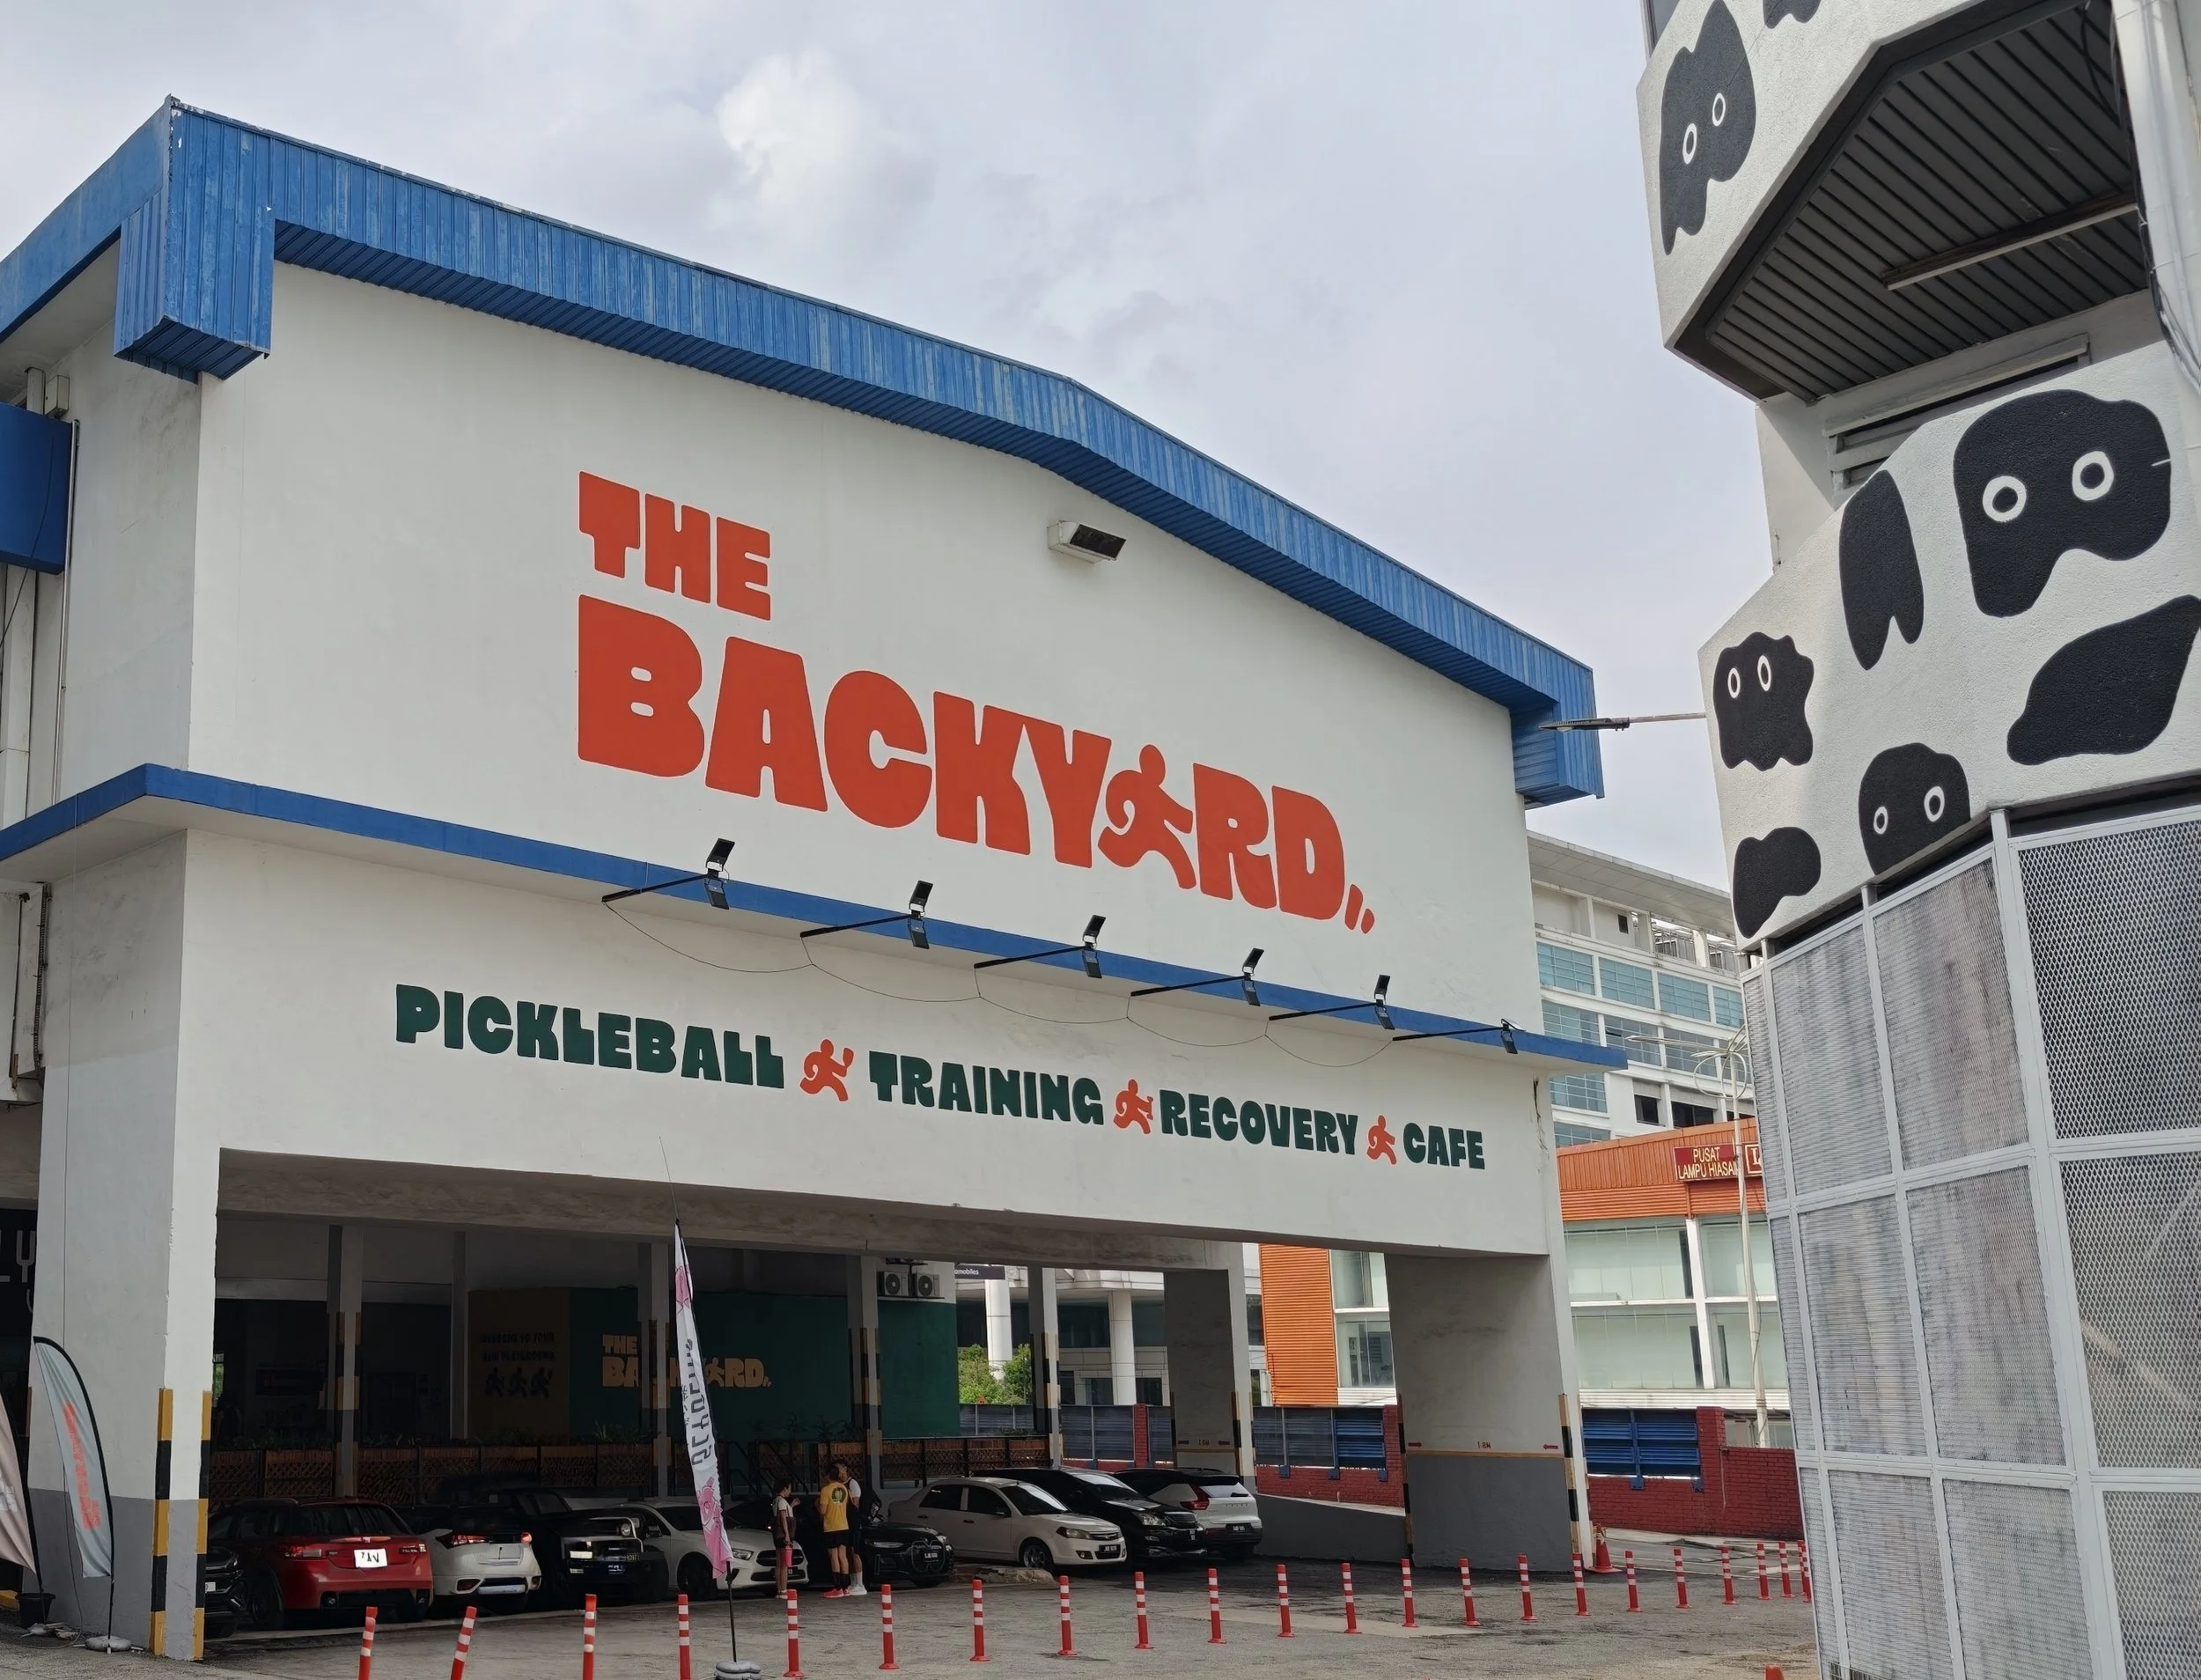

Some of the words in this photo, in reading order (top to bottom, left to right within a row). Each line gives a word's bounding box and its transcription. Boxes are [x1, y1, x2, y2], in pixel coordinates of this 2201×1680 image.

[578, 470, 771, 622] THE
[395, 984, 784, 1089] PICKLEBALL
[869, 1050, 1104, 1125] TRAINING
[1159, 1090, 1358, 1155] RECOVERY
[1403, 1123, 1485, 1170] CAFE
[1693, 1146, 1720, 1163] PUSAT
[1677, 1162, 1707, 1180] LAMPU
[602, 1334, 637, 1354] THE
